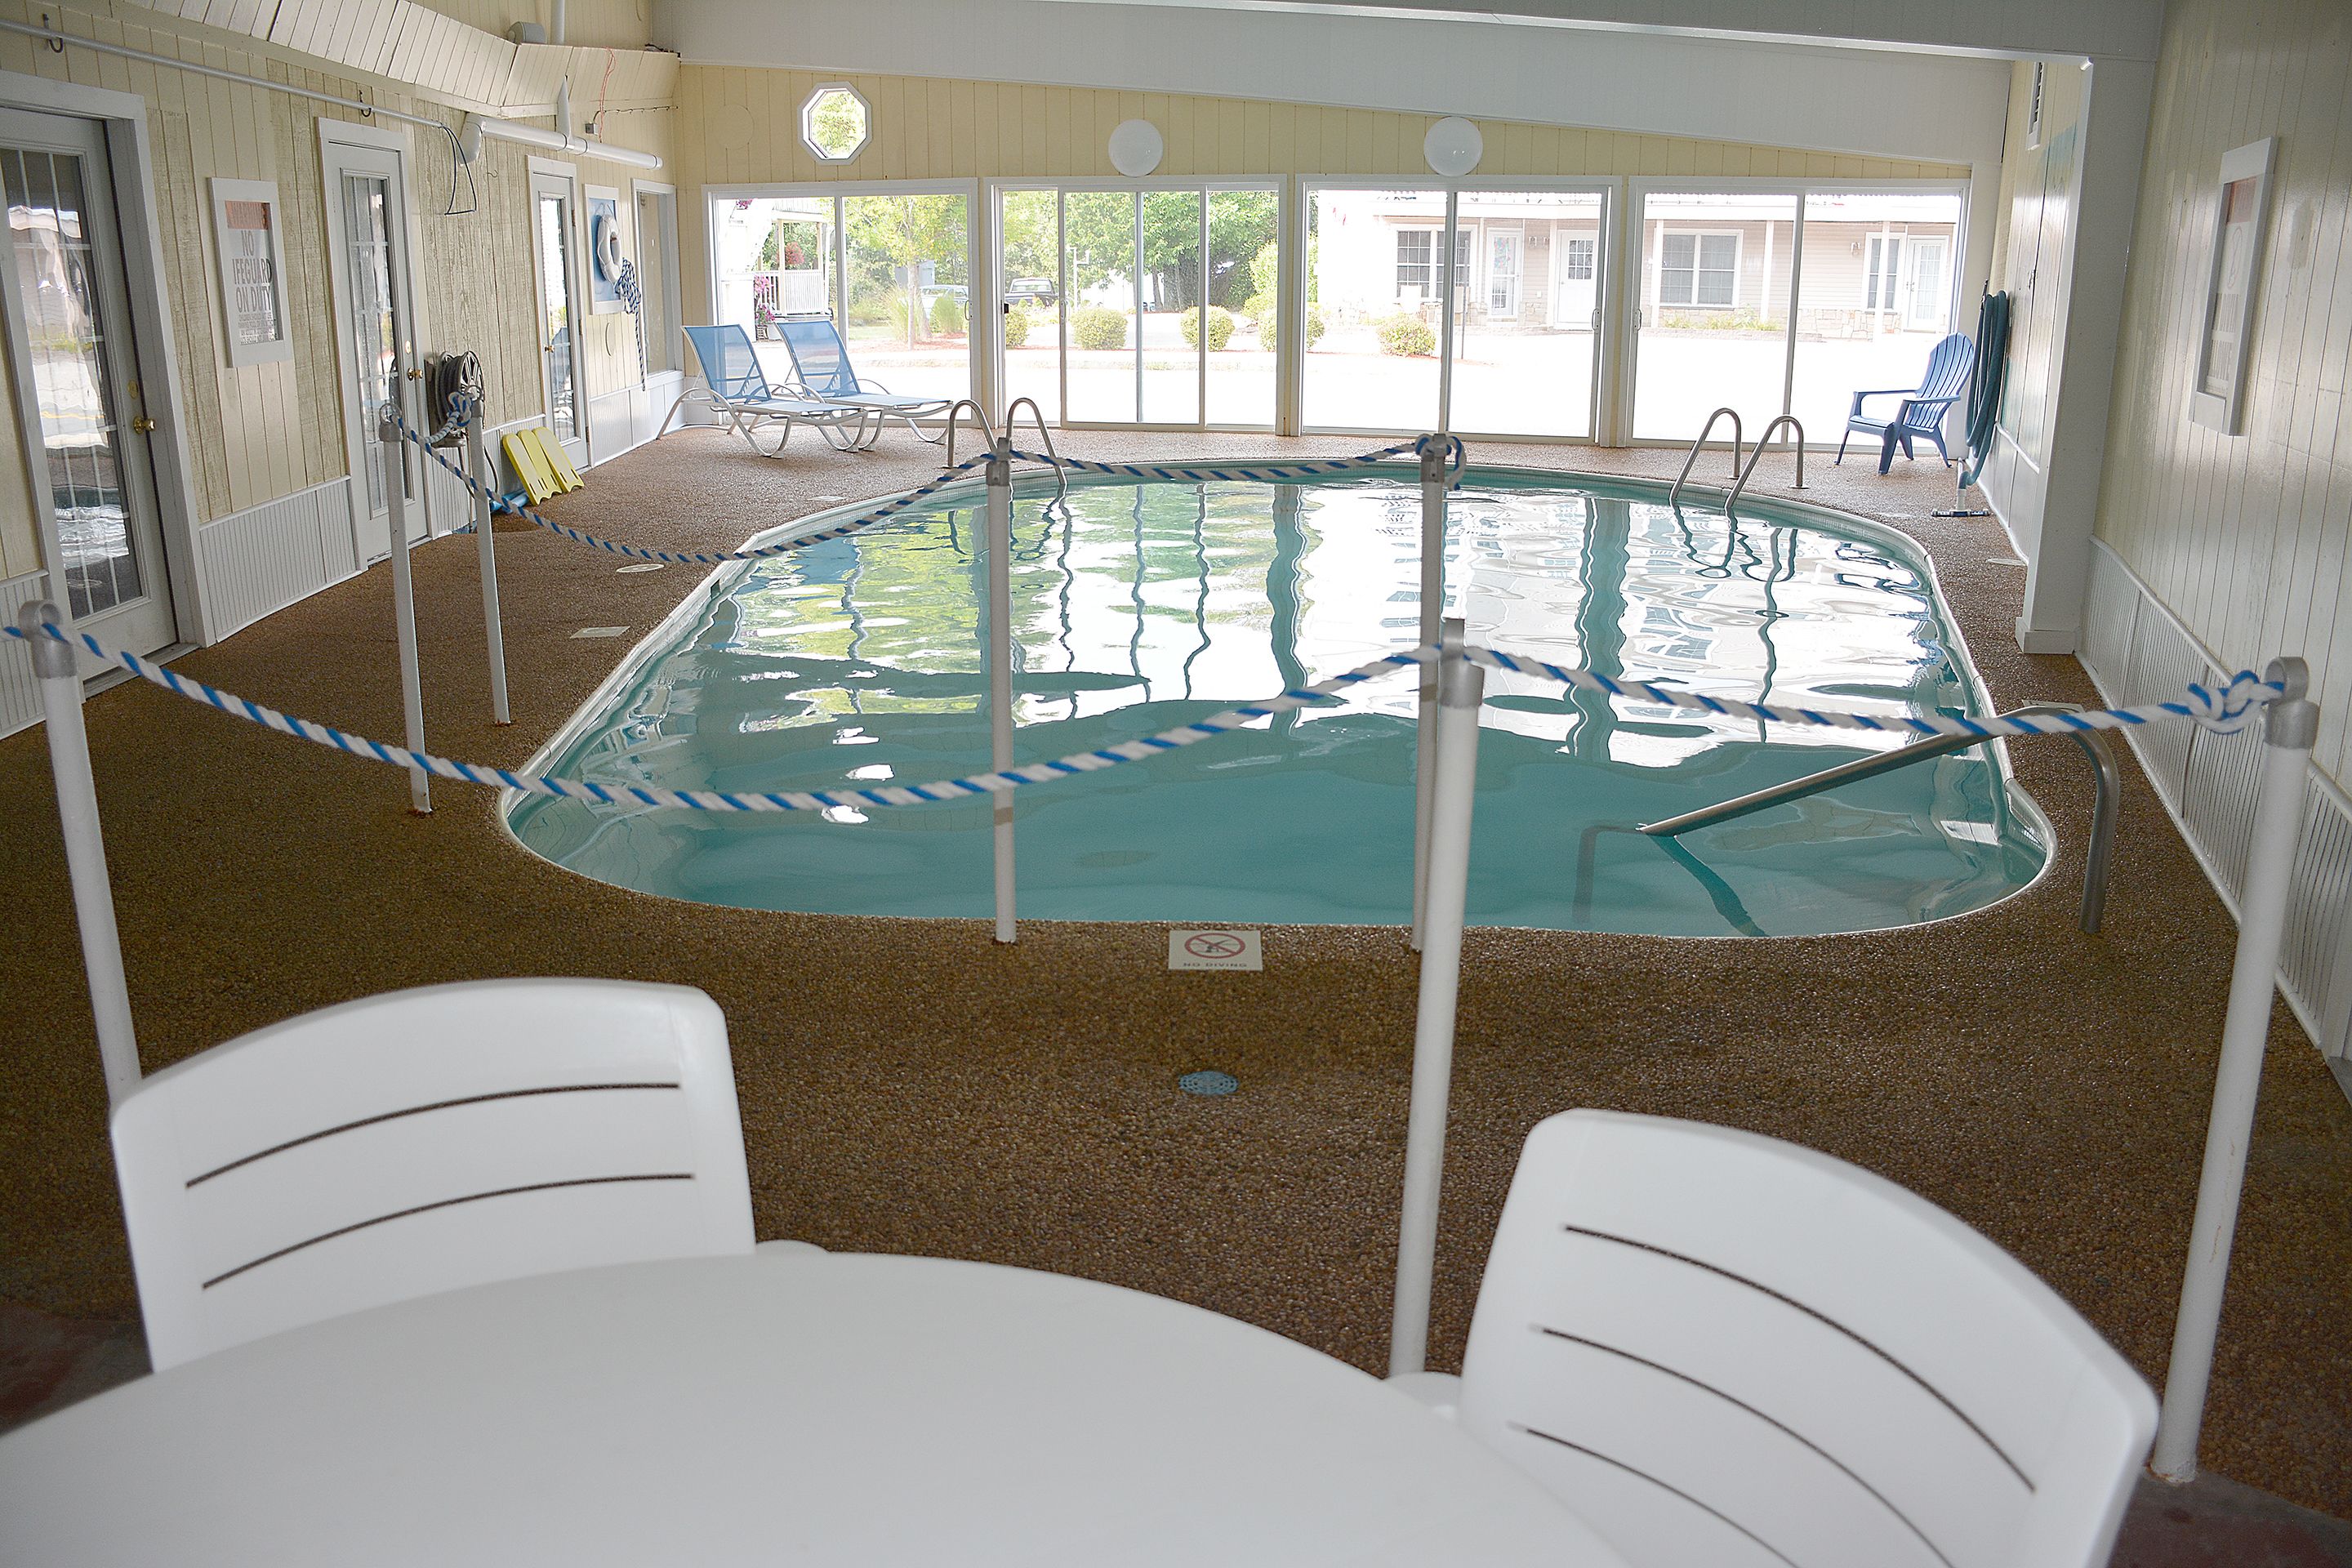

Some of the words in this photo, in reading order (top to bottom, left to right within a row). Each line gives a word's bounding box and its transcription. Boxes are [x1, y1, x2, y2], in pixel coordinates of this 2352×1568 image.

[241, 229, 254, 256] NO
[232, 258, 272, 284] IFEGUARD
[236, 286, 249, 313] ON
[251, 286, 271, 312] DUTY
